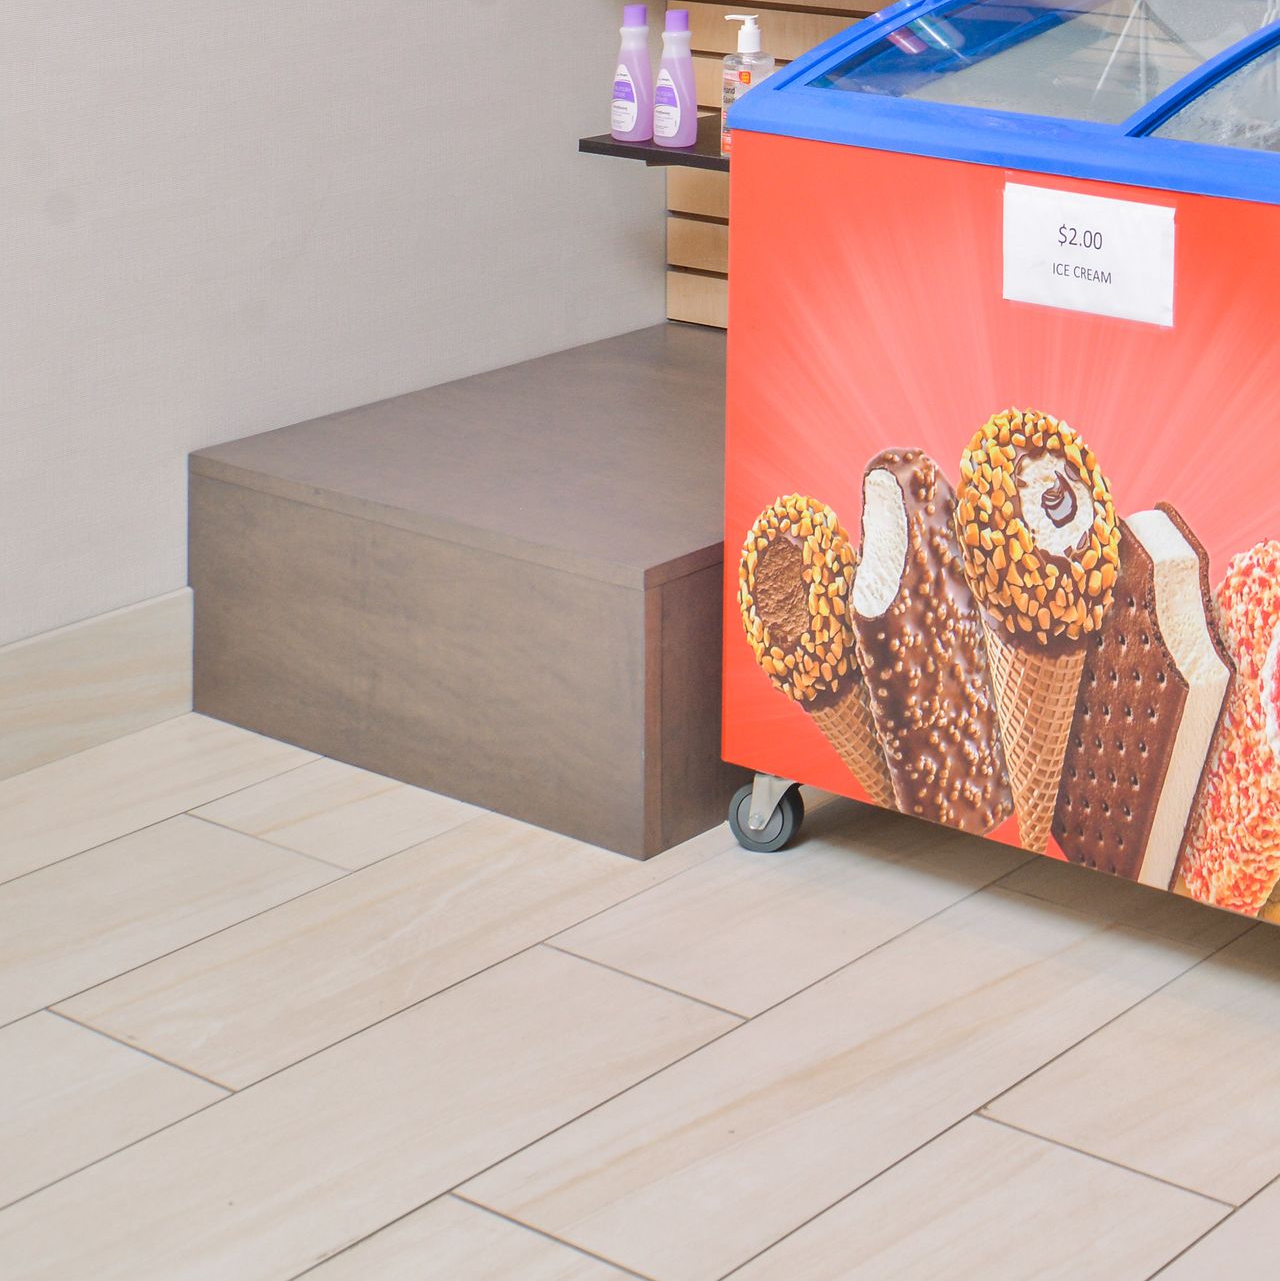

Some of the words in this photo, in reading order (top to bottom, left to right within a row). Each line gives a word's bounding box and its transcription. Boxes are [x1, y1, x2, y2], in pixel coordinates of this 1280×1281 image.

[1058, 224, 1103, 250] $2.00
[1052, 262, 1070, 276] ICE
[1073, 265, 1112, 285] CREAM
